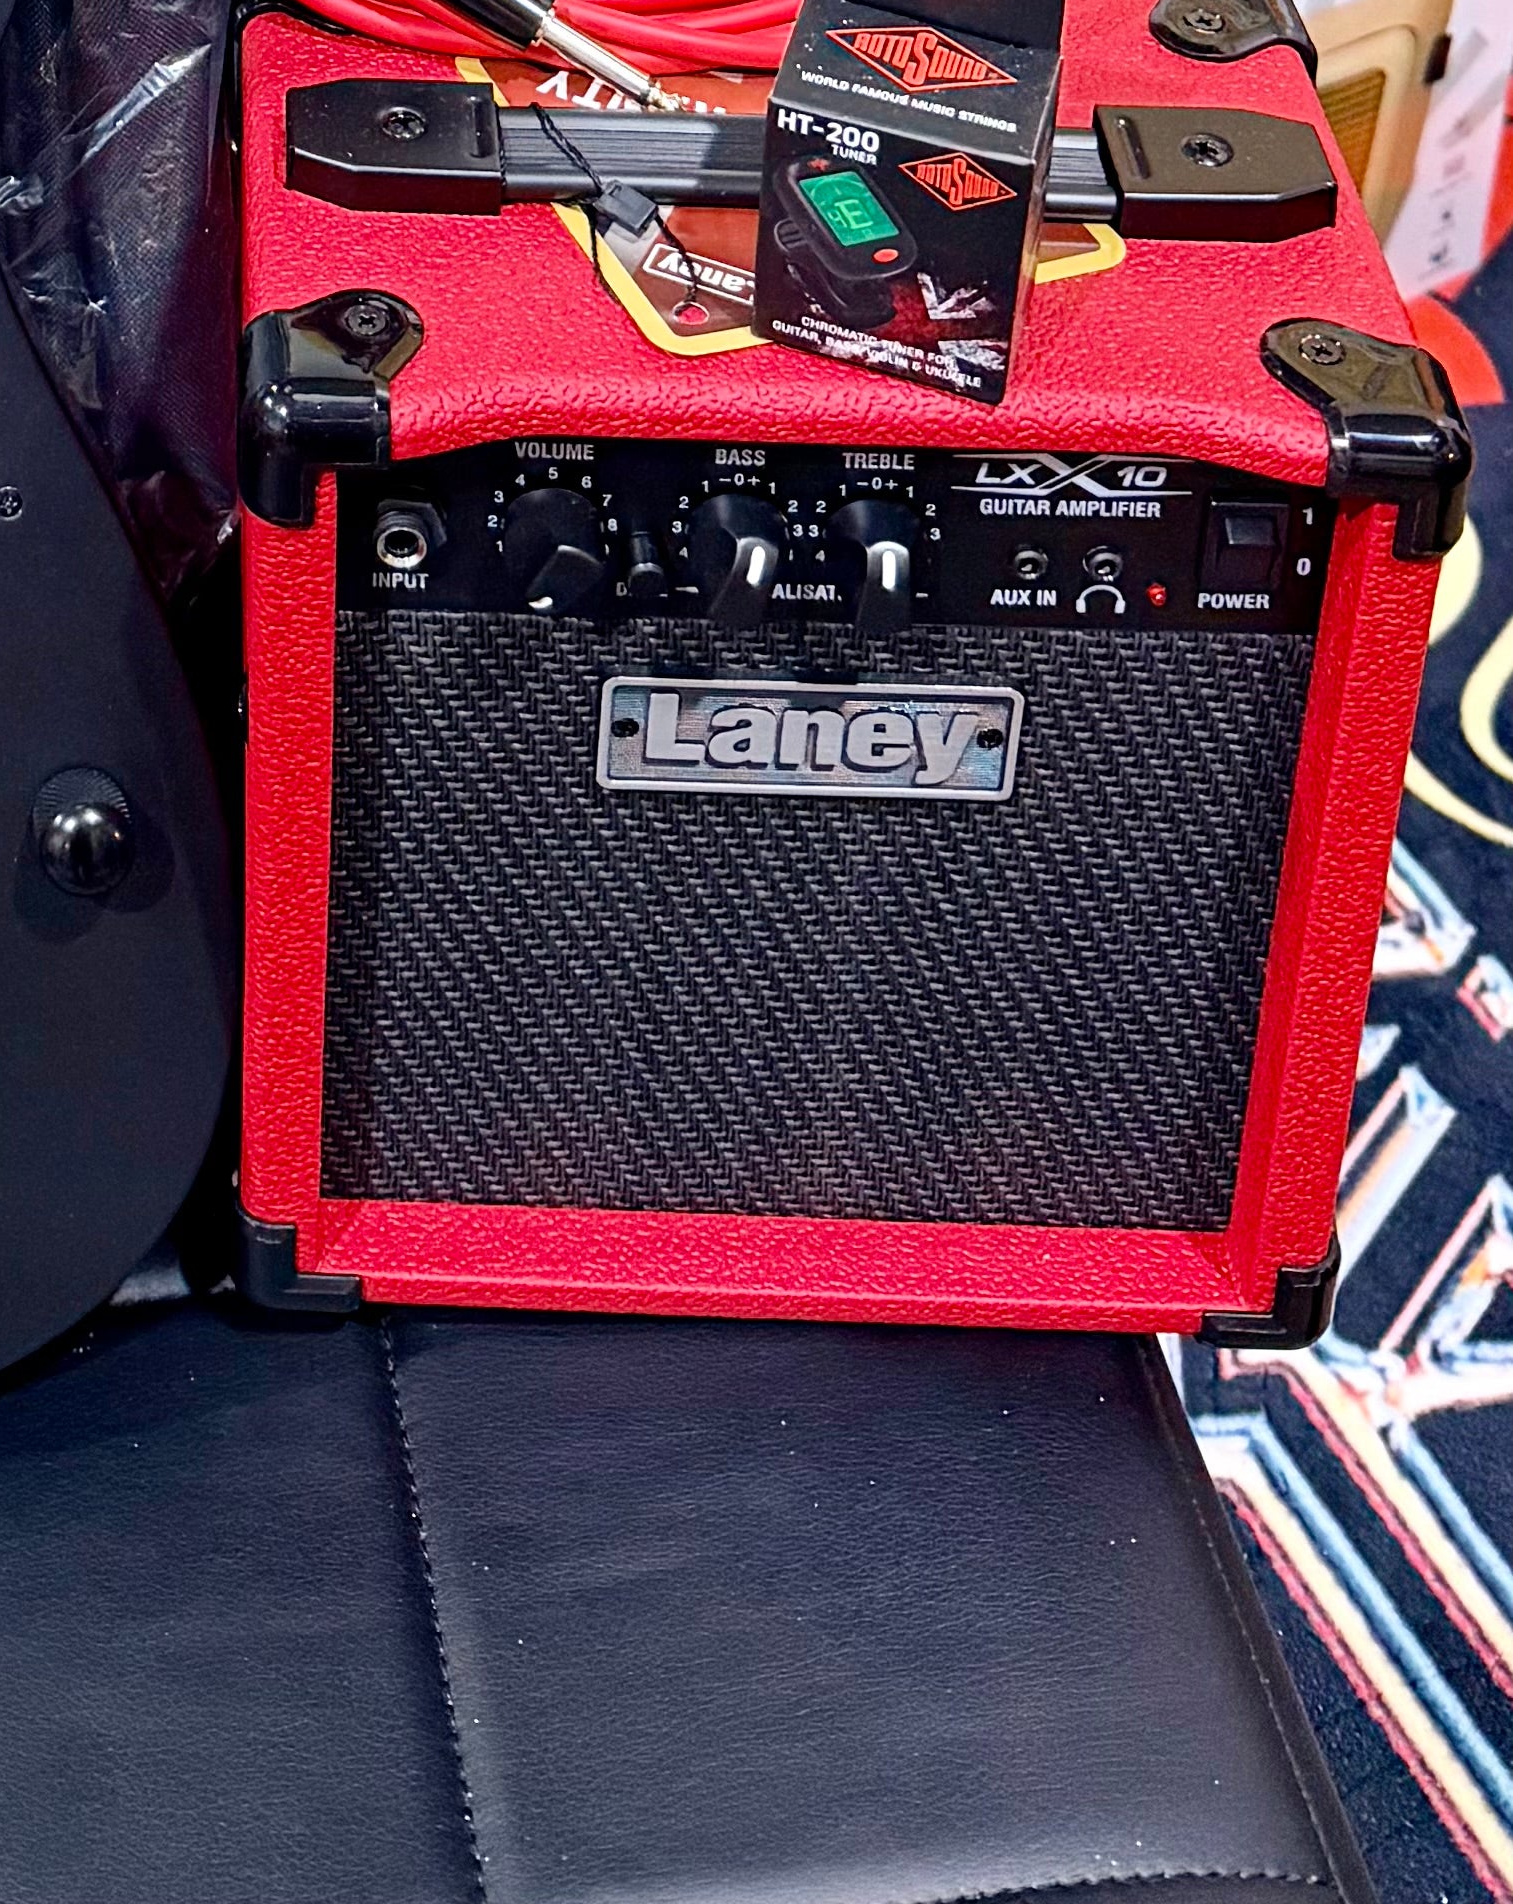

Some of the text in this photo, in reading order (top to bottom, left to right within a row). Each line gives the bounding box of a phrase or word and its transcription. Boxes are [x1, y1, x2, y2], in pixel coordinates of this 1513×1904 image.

[801, 70, 1018, 134] WORLD FAMOUS MUSIC STRINGS
[777, 108, 880, 153] HT-200
[831, 143, 877, 166] TUNER
[657, 252, 756, 293] aney
[772, 319, 822, 346] GUITAR,
[801, 316, 877, 345] CHROMATIC
[880, 339, 925, 360] TUNER
[515, 441, 594, 460] VOLUME
[715, 449, 765, 466] BASS
[843, 452, 915, 471] TREBLE
[548, 467, 558, 480] 5
[515, 474, 526, 487] 4
[581, 476, 592, 488] 6
[702, 480, 709, 493] 1
[769, 481, 776, 494] 1
[839, 484, 846, 496] 1
[906, 486, 914, 498] 1
[494, 490, 504, 503] 3
[602, 494, 612, 507] 7
[679, 496, 689, 509] 2
[788, 500, 799, 512] 2
[815, 500, 826, 513] 2
[925, 504, 936, 516] 2
[979, 498, 1161, 518] GUITAR AMPLIFIER
[487, 515, 498, 528] 2
[607, 518, 618, 532] 8
[672, 521, 682, 533] 3
[793, 524, 804, 536] 3
[808, 525, 819, 537] 3
[930, 527, 941, 540] 3
[371, 572, 429, 590] INPUT
[990, 589, 1056, 607] AUX IN
[1198, 593, 1270, 610] POWER
[646, 690, 980, 786] Laney
